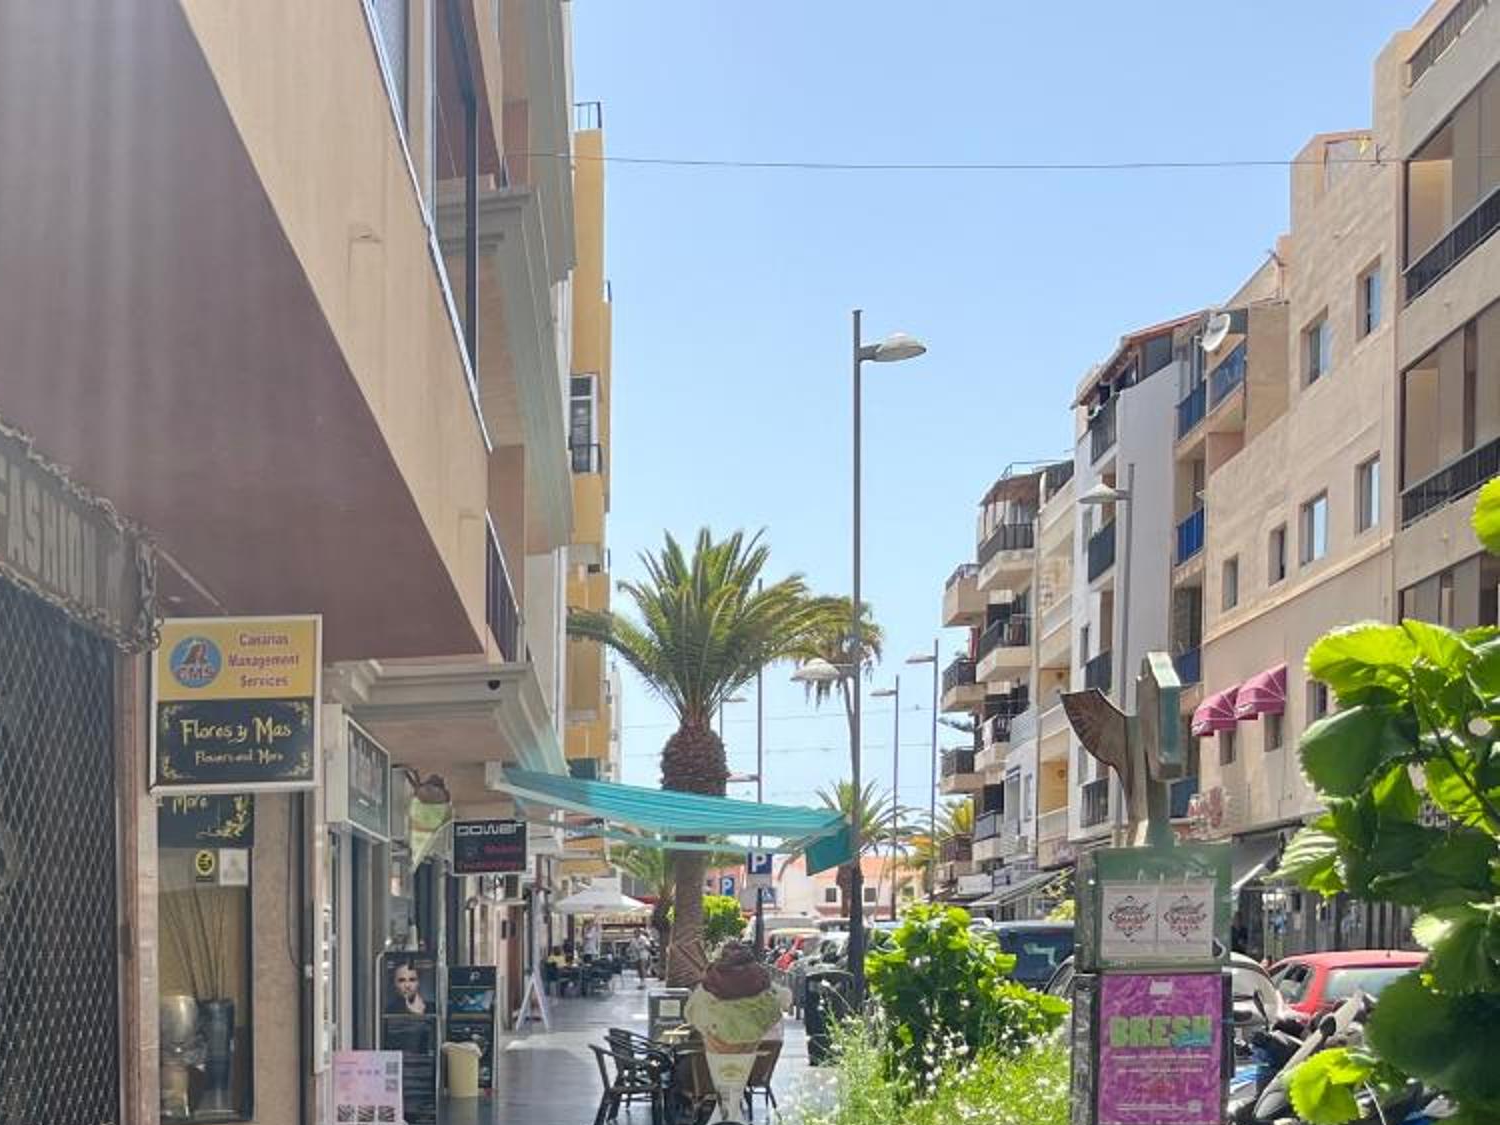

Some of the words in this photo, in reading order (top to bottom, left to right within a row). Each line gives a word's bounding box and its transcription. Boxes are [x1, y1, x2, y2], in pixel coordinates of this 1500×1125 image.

[227, 654, 299, 669] Management
[240, 674, 289, 687] Services
[180, 719, 233, 746] Flores
[252, 716, 292, 744] Mas
[751, 852, 767, 873] P
